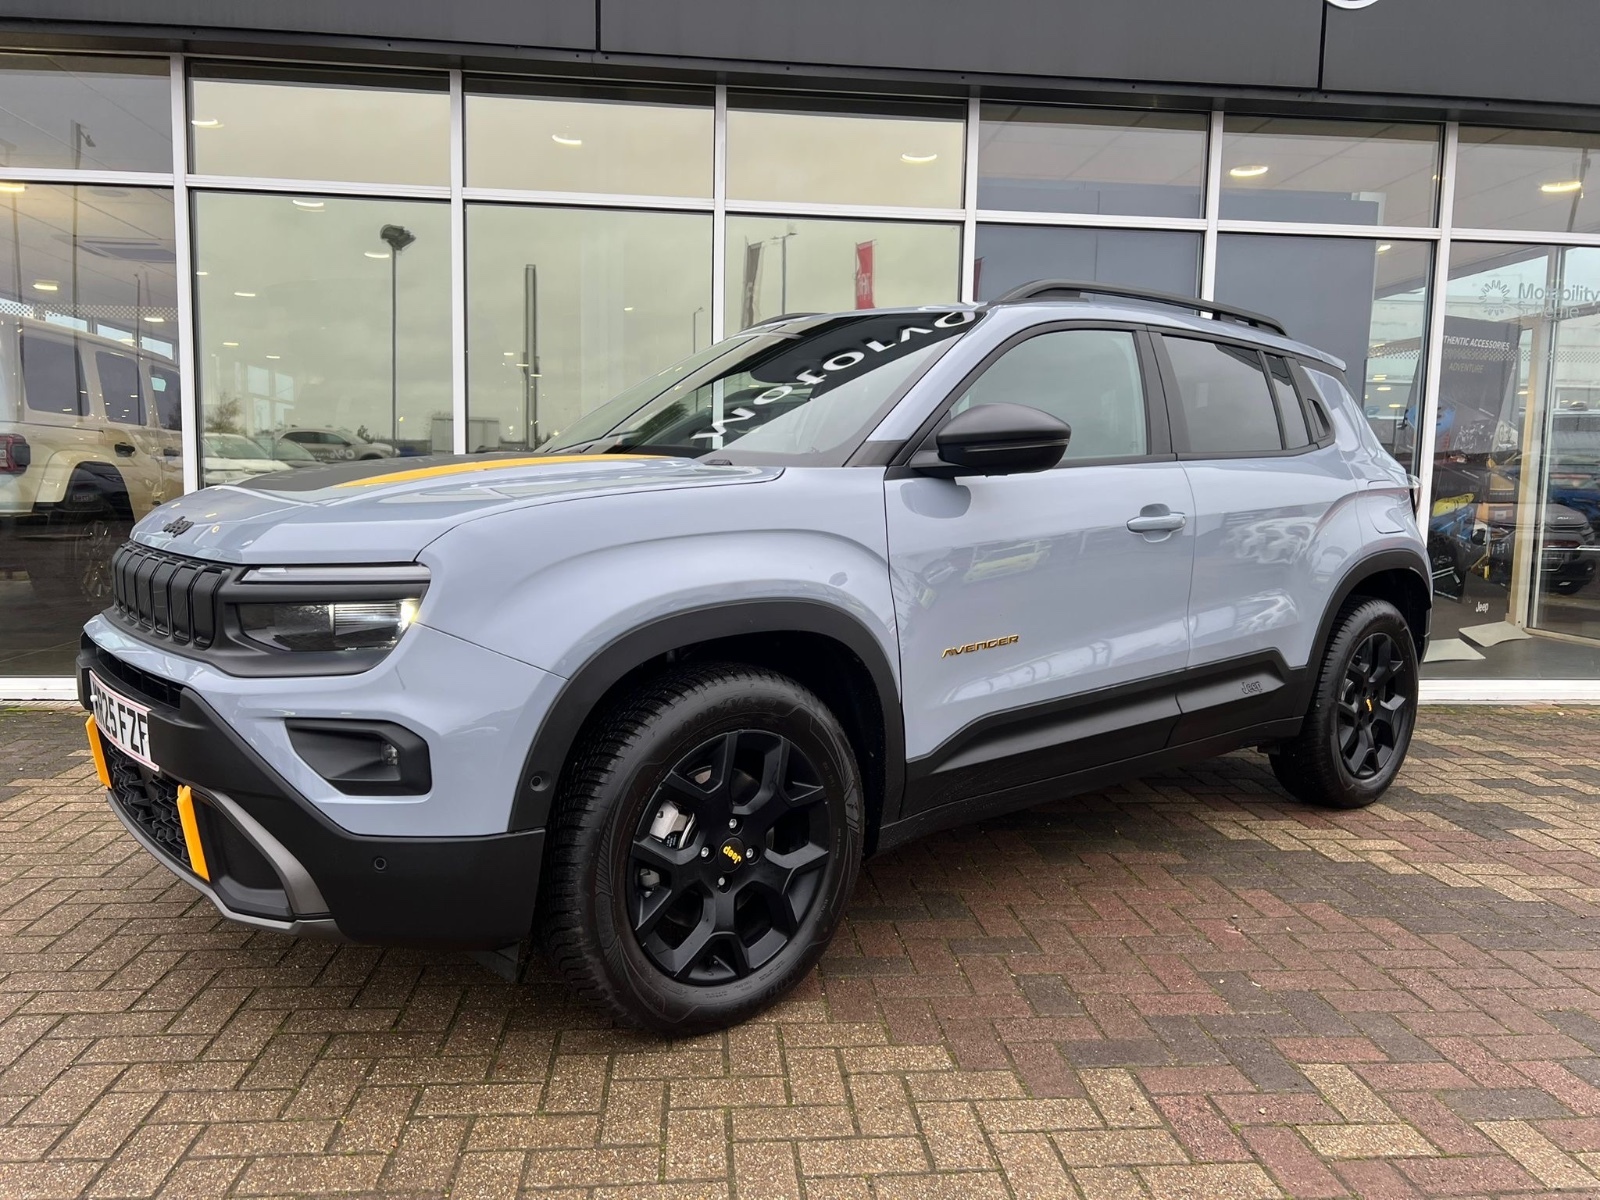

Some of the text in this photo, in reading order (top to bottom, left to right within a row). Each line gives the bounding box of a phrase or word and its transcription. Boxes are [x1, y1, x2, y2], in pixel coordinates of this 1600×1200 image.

[1470, 338, 1510, 351] ACCESSORIES
[1449, 362, 1485, 374] ADVENTURE
[163, 516, 194, 538] Jeep
[1475, 601, 1489, 613] Jeep
[941, 634, 1020, 658] AVENGER
[1241, 681, 1263, 695] Jeep
[117, 702, 148, 757] FZF
[722, 845, 742, 865] Jeep
